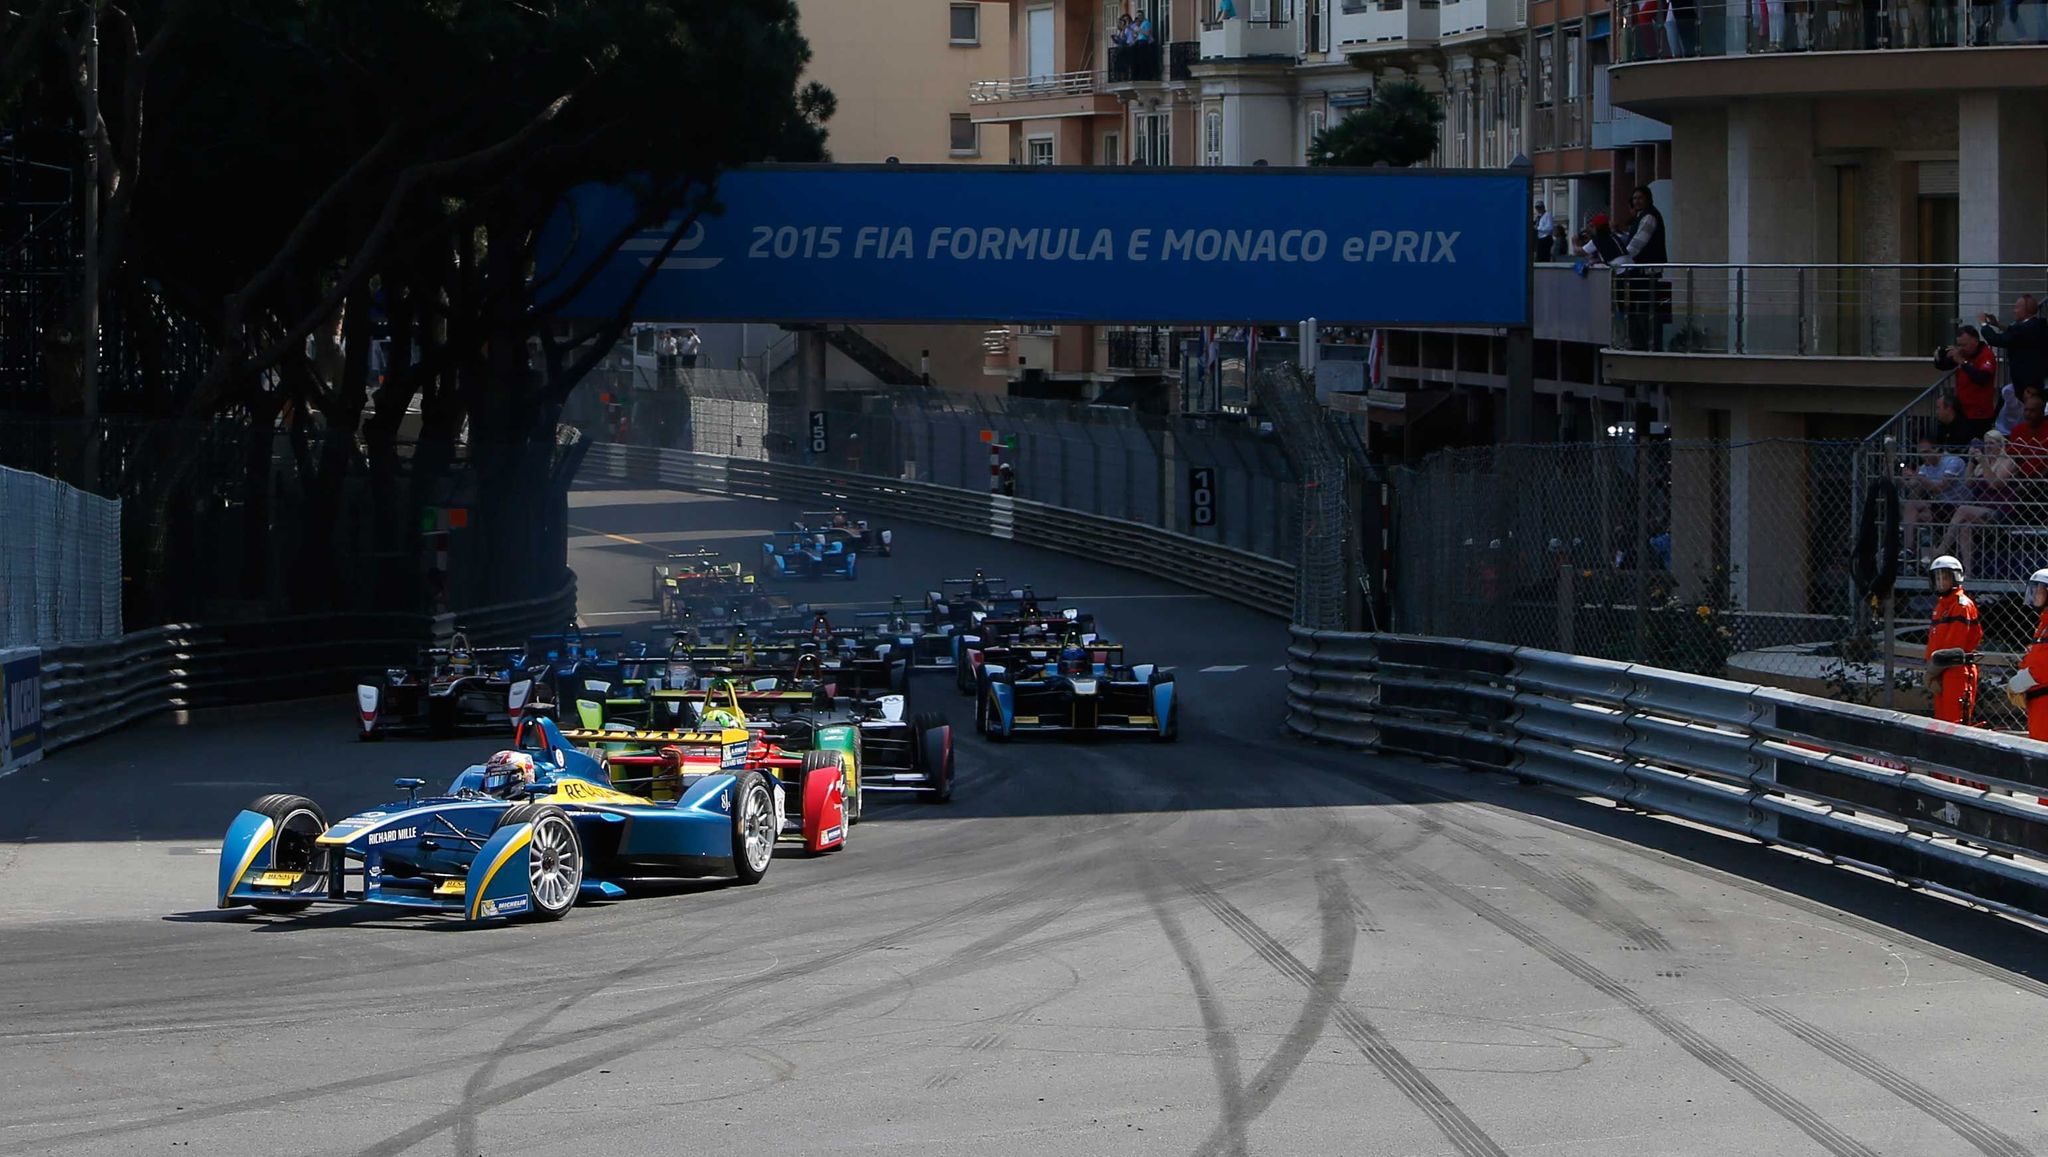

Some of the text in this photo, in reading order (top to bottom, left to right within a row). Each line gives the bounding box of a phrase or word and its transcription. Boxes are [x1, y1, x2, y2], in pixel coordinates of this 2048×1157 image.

[748, 226, 1462, 264] 2015 FIA FORMULA E MONACO ePRIX
[813, 412, 826, 452] 150
[1194, 471, 1211, 523] 100
[368, 827, 417, 845] RICHARD MILLE
[498, 899, 528, 909] MICHELIN
